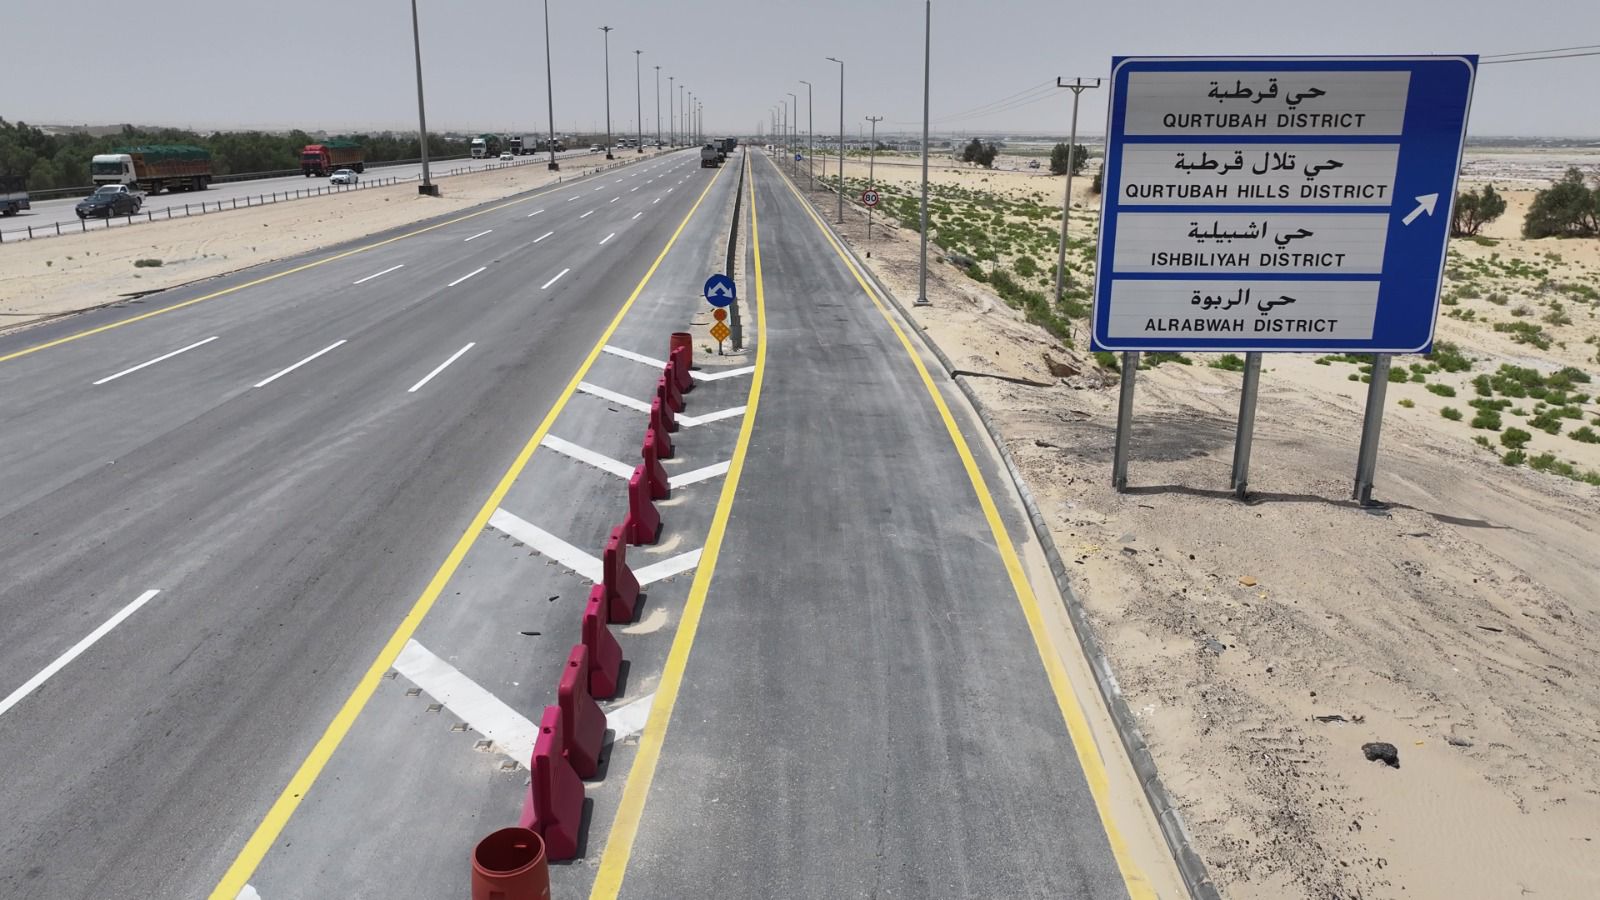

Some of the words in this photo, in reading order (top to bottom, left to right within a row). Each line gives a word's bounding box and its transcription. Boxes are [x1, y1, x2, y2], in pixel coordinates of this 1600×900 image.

[1207, 78, 1279, 104] قرطبة
[1285, 87, 1326, 111] حي
[1163, 113, 1267, 128] QURTUBAH
[1277, 113, 1366, 128] DISTRICT
[1174, 150, 1244, 176] قرطبة
[1252, 151, 1296, 176] تلال
[1303, 159, 1344, 181] حي
[865, 194, 877, 202] 80
[1125, 183, 1228, 199] QURTUBAH
[1237, 184, 1290, 199] HILLS
[1300, 184, 1388, 199] DISTRICT
[1187, 220, 1268, 244] اشبيلية
[1274, 228, 1314, 250] حي
[1151, 251, 1250, 267] ISHBILIYAH
[1259, 252, 1346, 267] DISTRICT
[1191, 288, 1251, 311] الربوة
[1257, 295, 1297, 316] حي
[1144, 318, 1245, 332] ALRABWAH
[1254, 318, 1338, 333] DISTRICT
